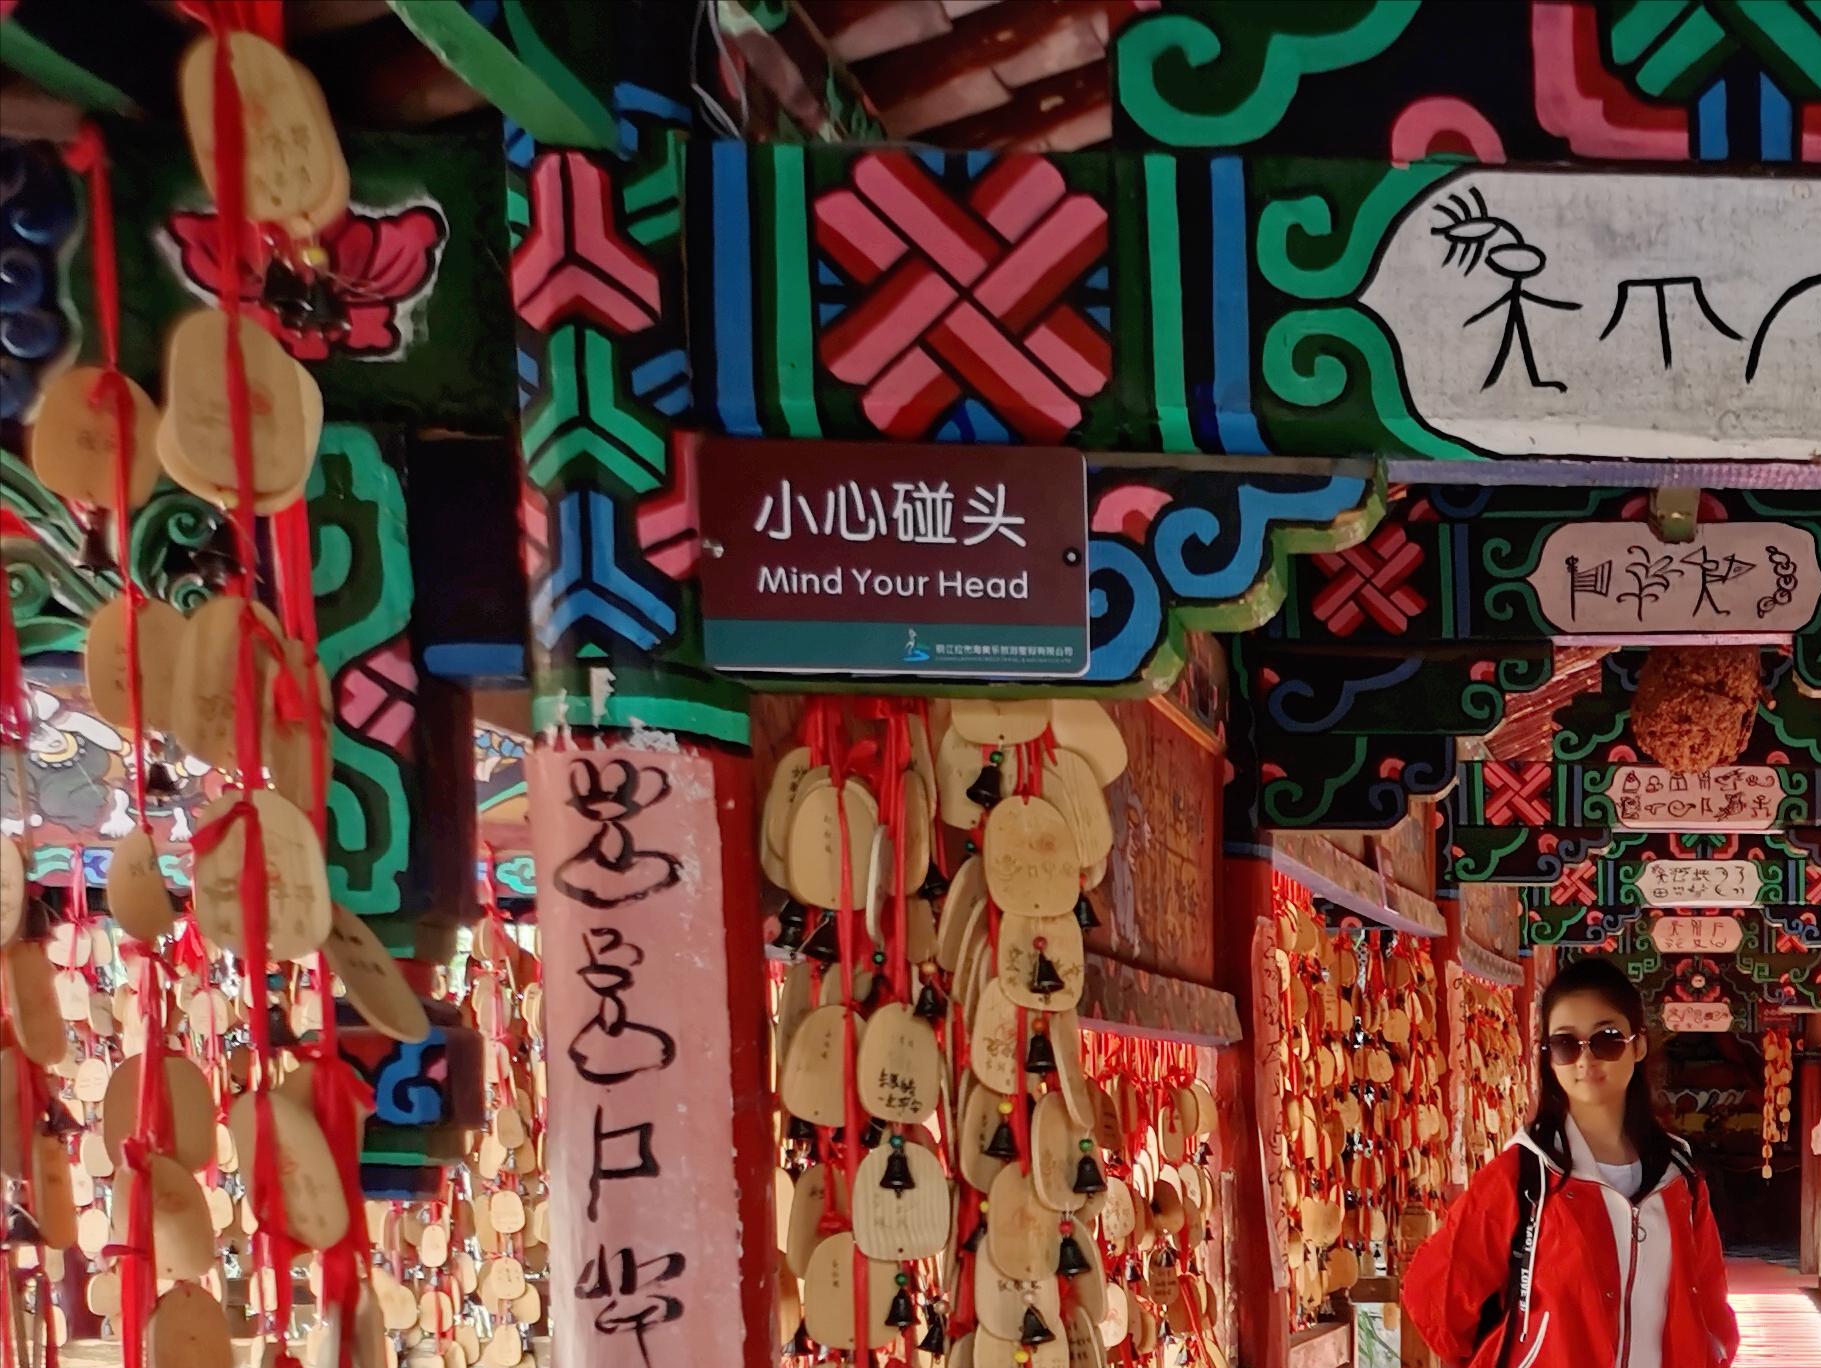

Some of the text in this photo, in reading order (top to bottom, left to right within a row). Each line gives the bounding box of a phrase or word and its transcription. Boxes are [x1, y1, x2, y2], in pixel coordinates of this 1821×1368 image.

[753, 480, 1027, 547] 小心碰头
[757, 565, 1029, 600] Mind Your Head
